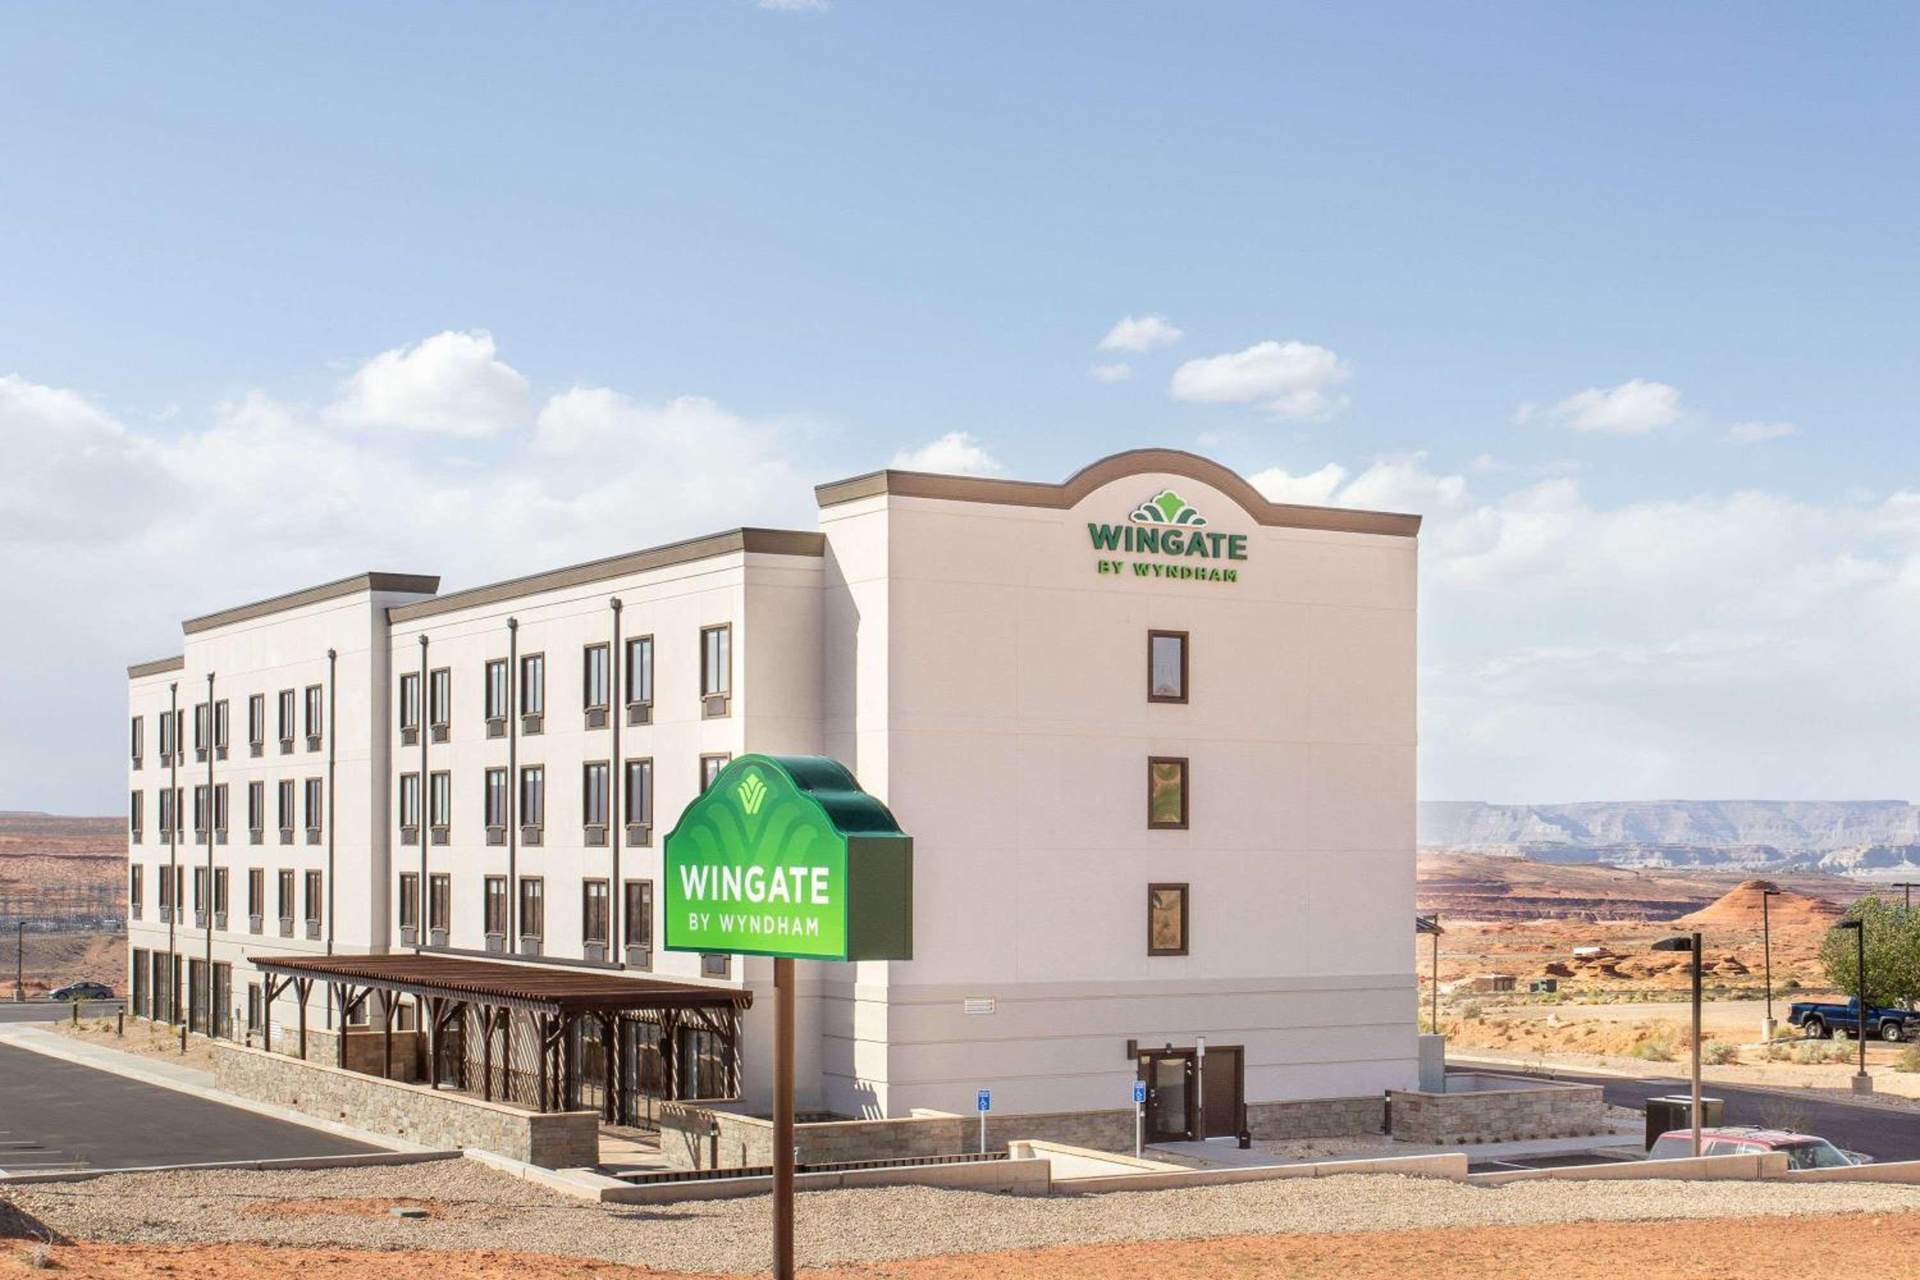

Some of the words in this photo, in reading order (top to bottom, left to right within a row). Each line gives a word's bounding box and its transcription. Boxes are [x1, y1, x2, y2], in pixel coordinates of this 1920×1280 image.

[1088, 522, 1248, 560] WINGATE
[1098, 560, 1124, 575] BY
[1133, 562, 1238, 582] WYNDHAM
[680, 864, 830, 905] WINGATE
[688, 912, 710, 931] BY
[719, 914, 819, 937] WYNDHAM
